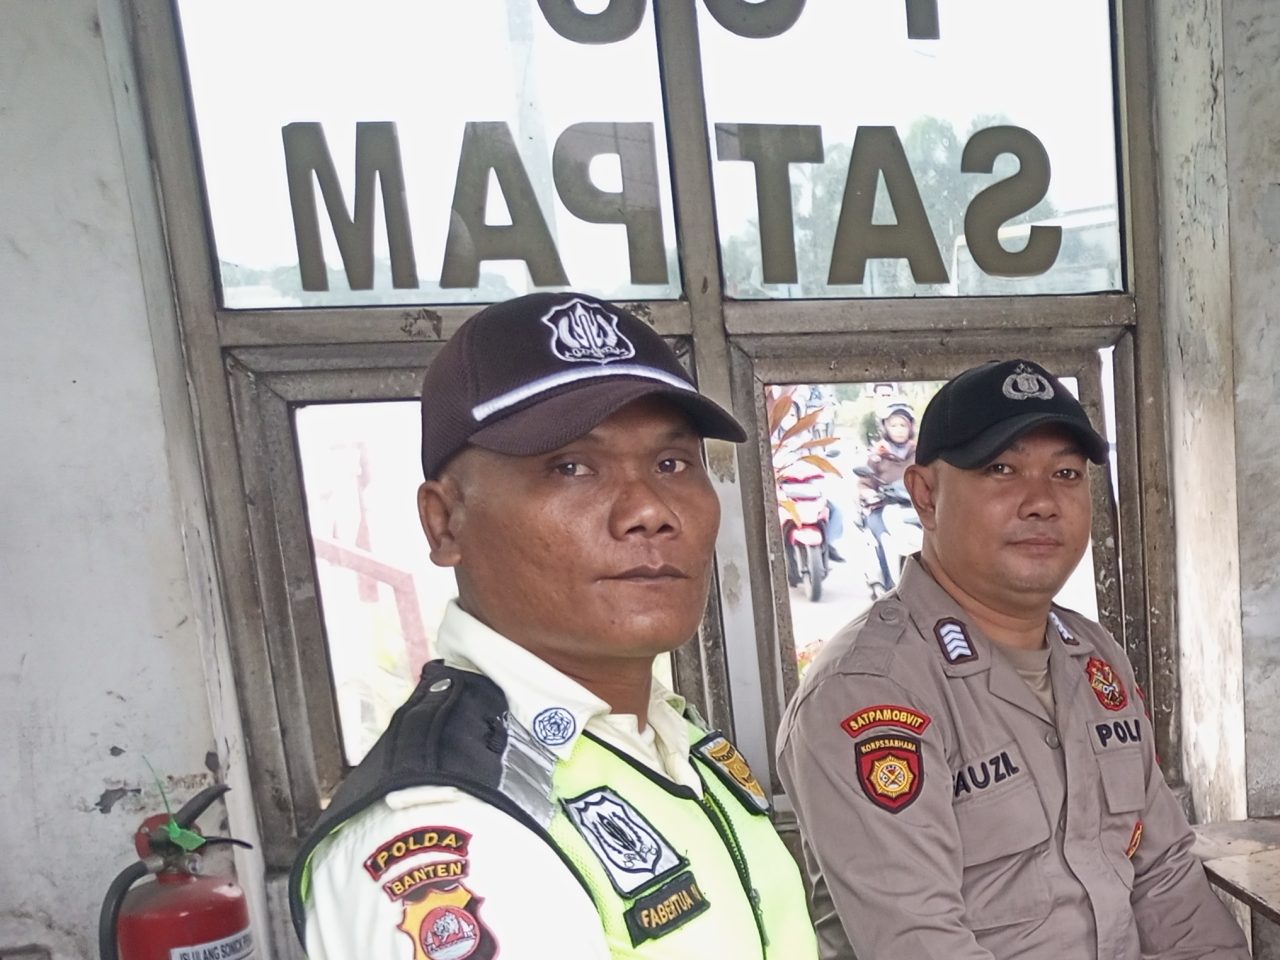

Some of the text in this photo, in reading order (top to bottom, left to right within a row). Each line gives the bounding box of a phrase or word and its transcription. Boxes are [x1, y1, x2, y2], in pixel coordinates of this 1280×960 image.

[849, 709, 924, 730] SATPAMOBVIT
[376, 832, 460, 868] POLDA
[391, 862, 463, 894] BANTEN
